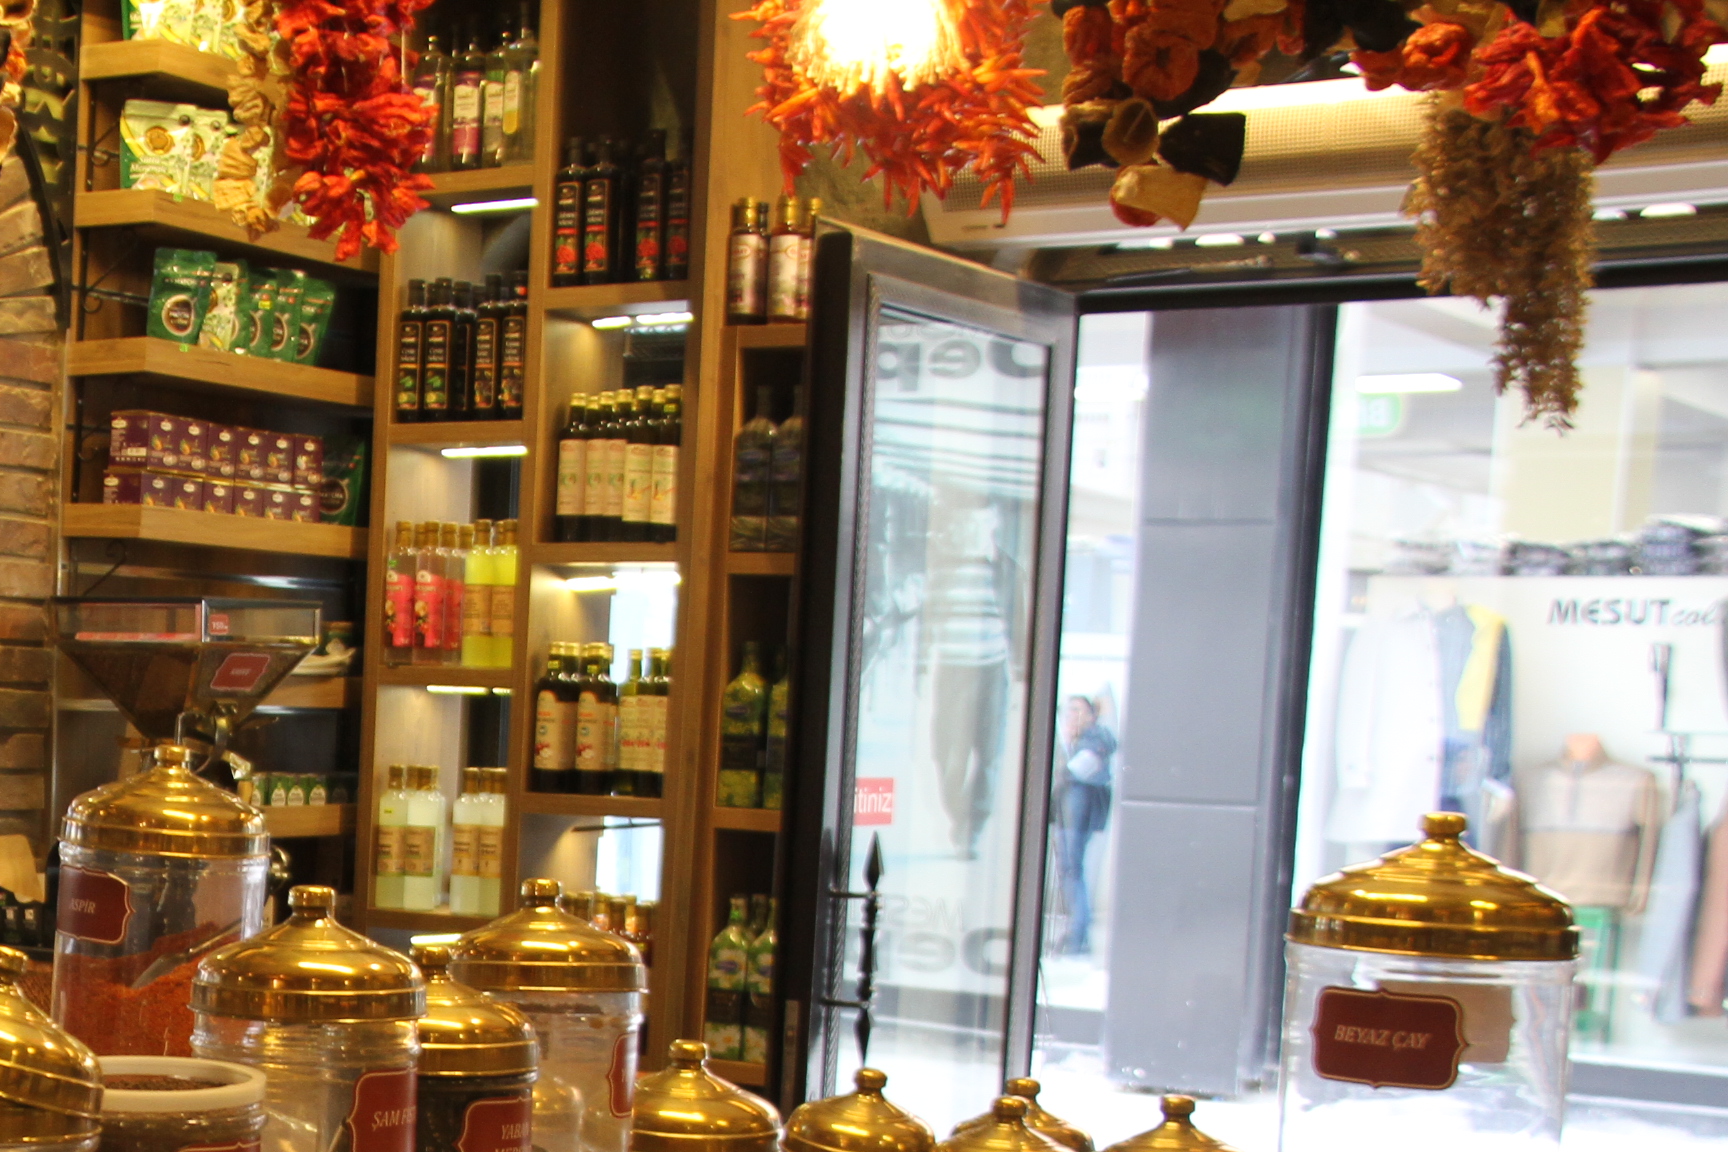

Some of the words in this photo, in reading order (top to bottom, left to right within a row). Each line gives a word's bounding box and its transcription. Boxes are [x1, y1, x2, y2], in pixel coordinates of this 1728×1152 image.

[1547, 597, 1671, 627] MESUT
[1334, 1024, 1390, 1049] BEYAZ
[1391, 1030, 1434, 1051] ÇAY
